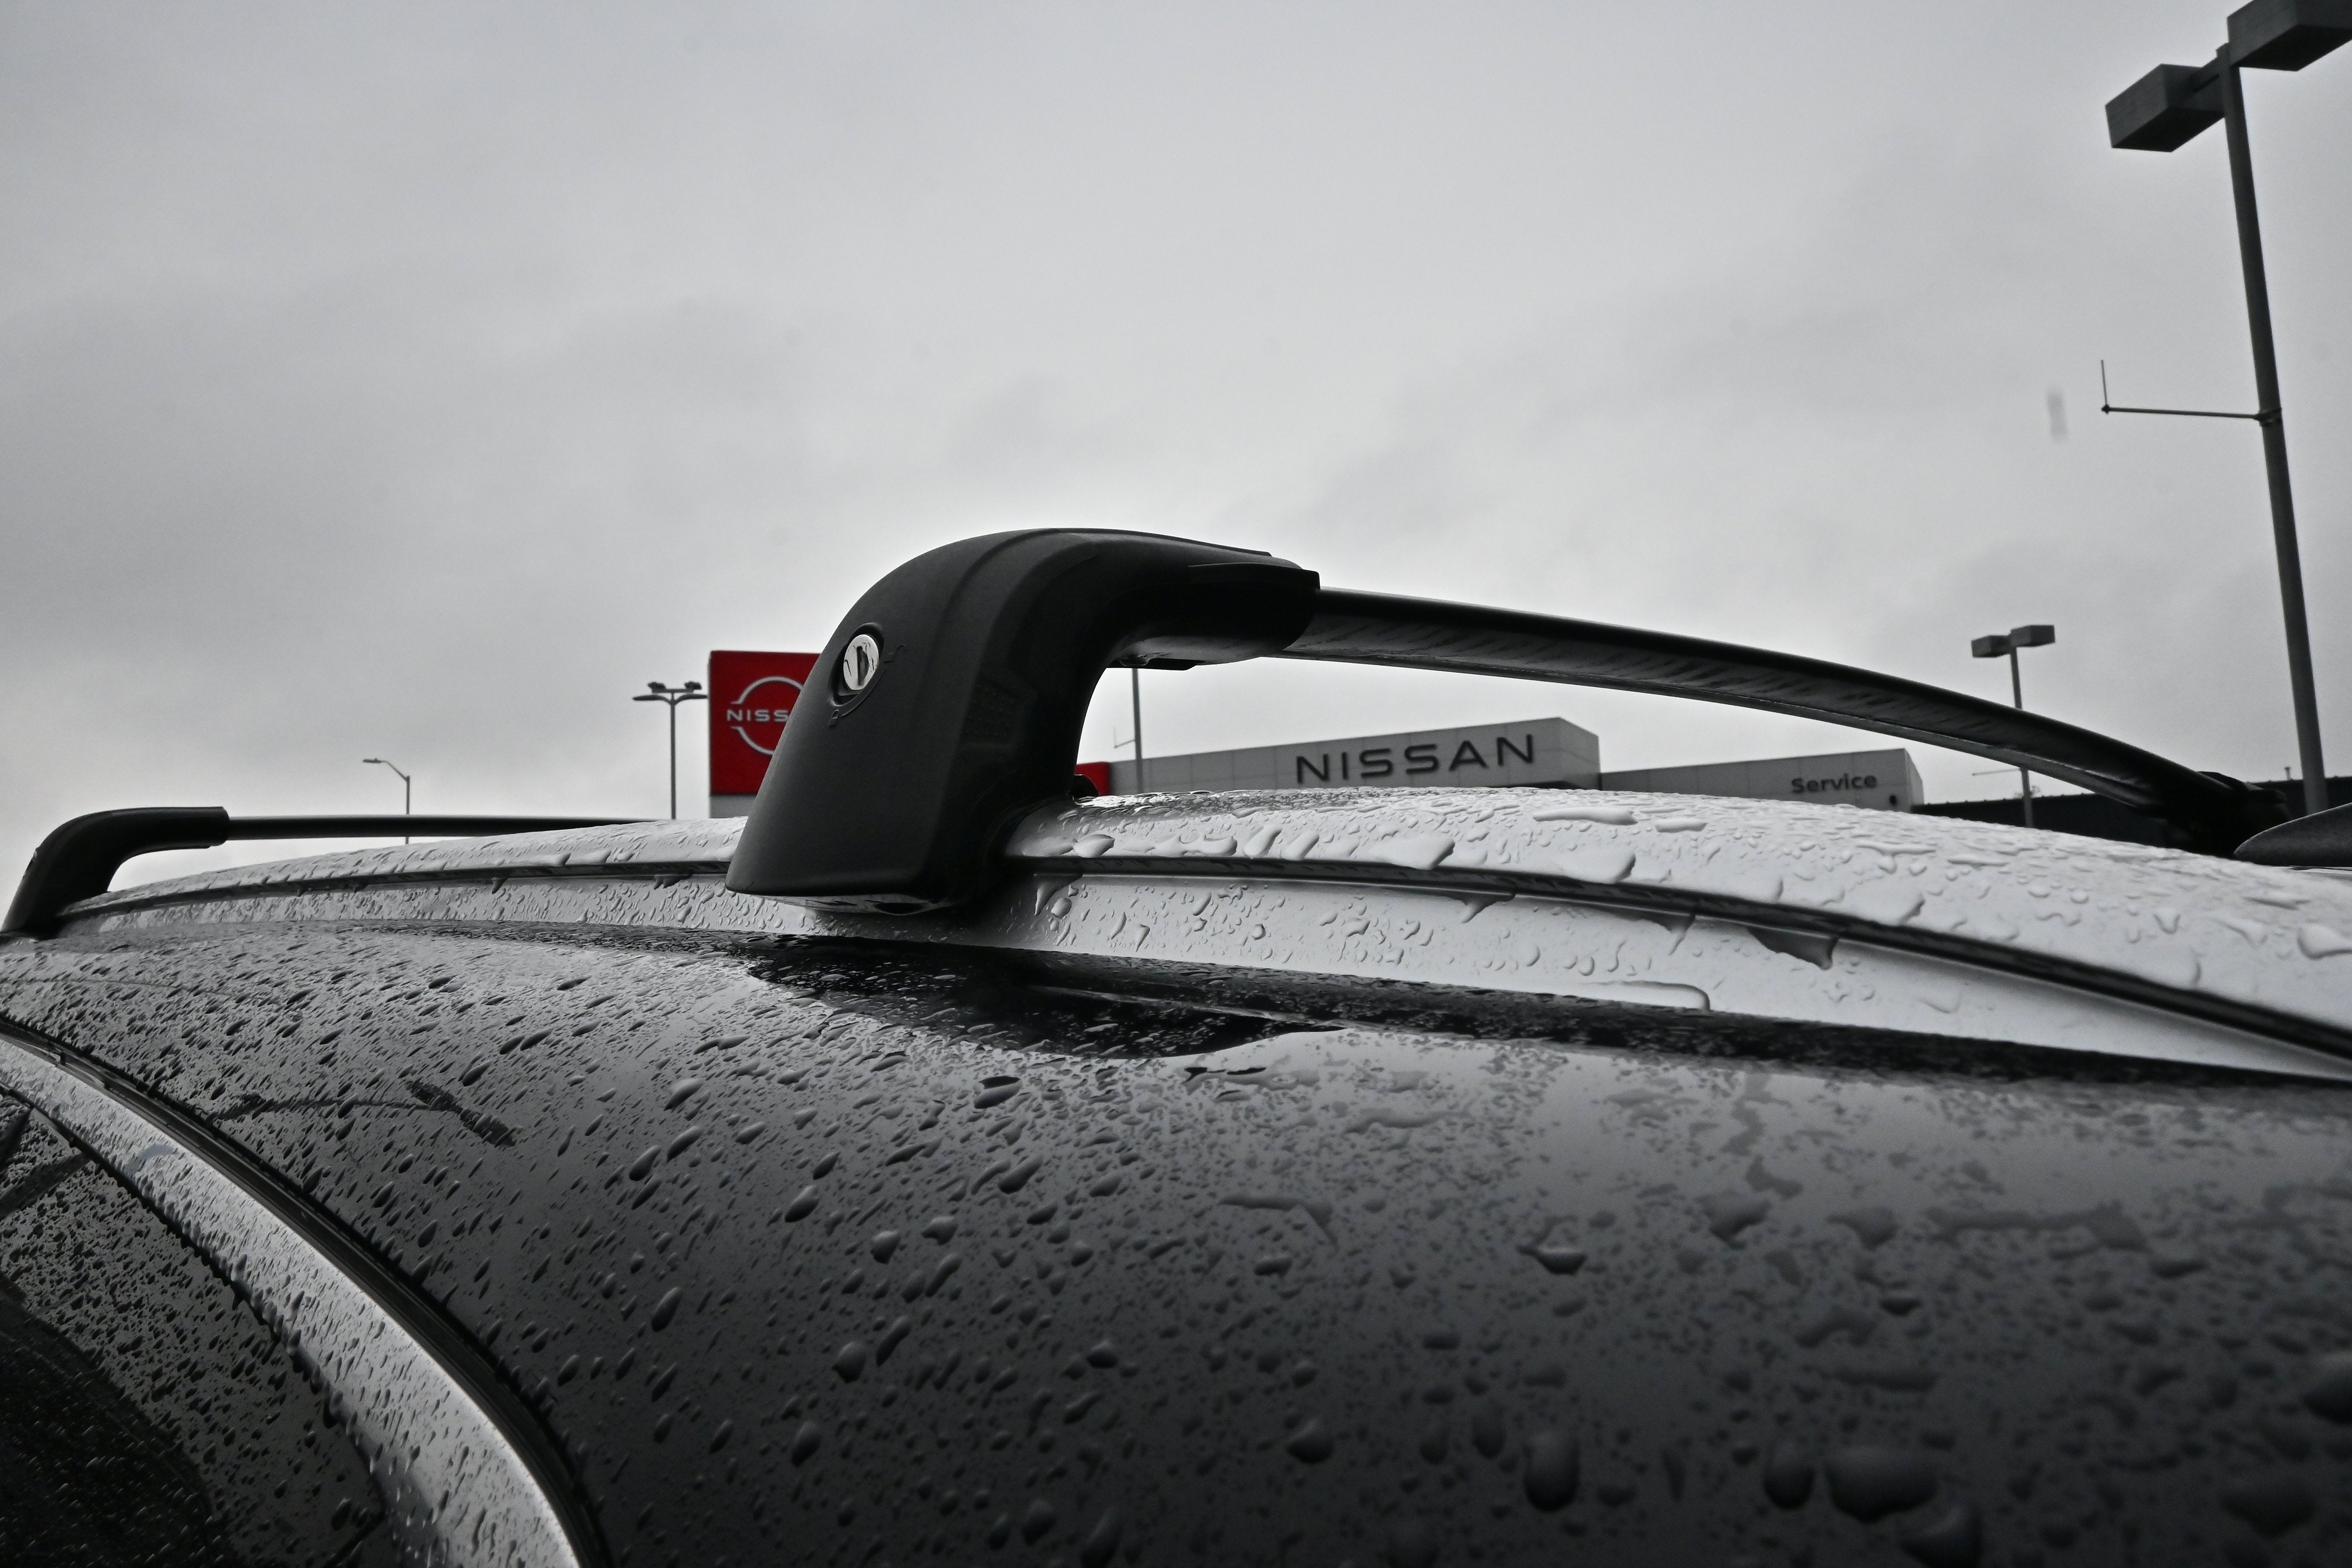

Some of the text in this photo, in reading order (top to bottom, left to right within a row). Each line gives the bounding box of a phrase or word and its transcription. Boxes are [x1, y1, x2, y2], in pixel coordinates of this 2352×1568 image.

[726, 709, 790, 722] NISS
[1296, 734, 1534, 784] NISSAN
[1791, 773, 1877, 793] Service
